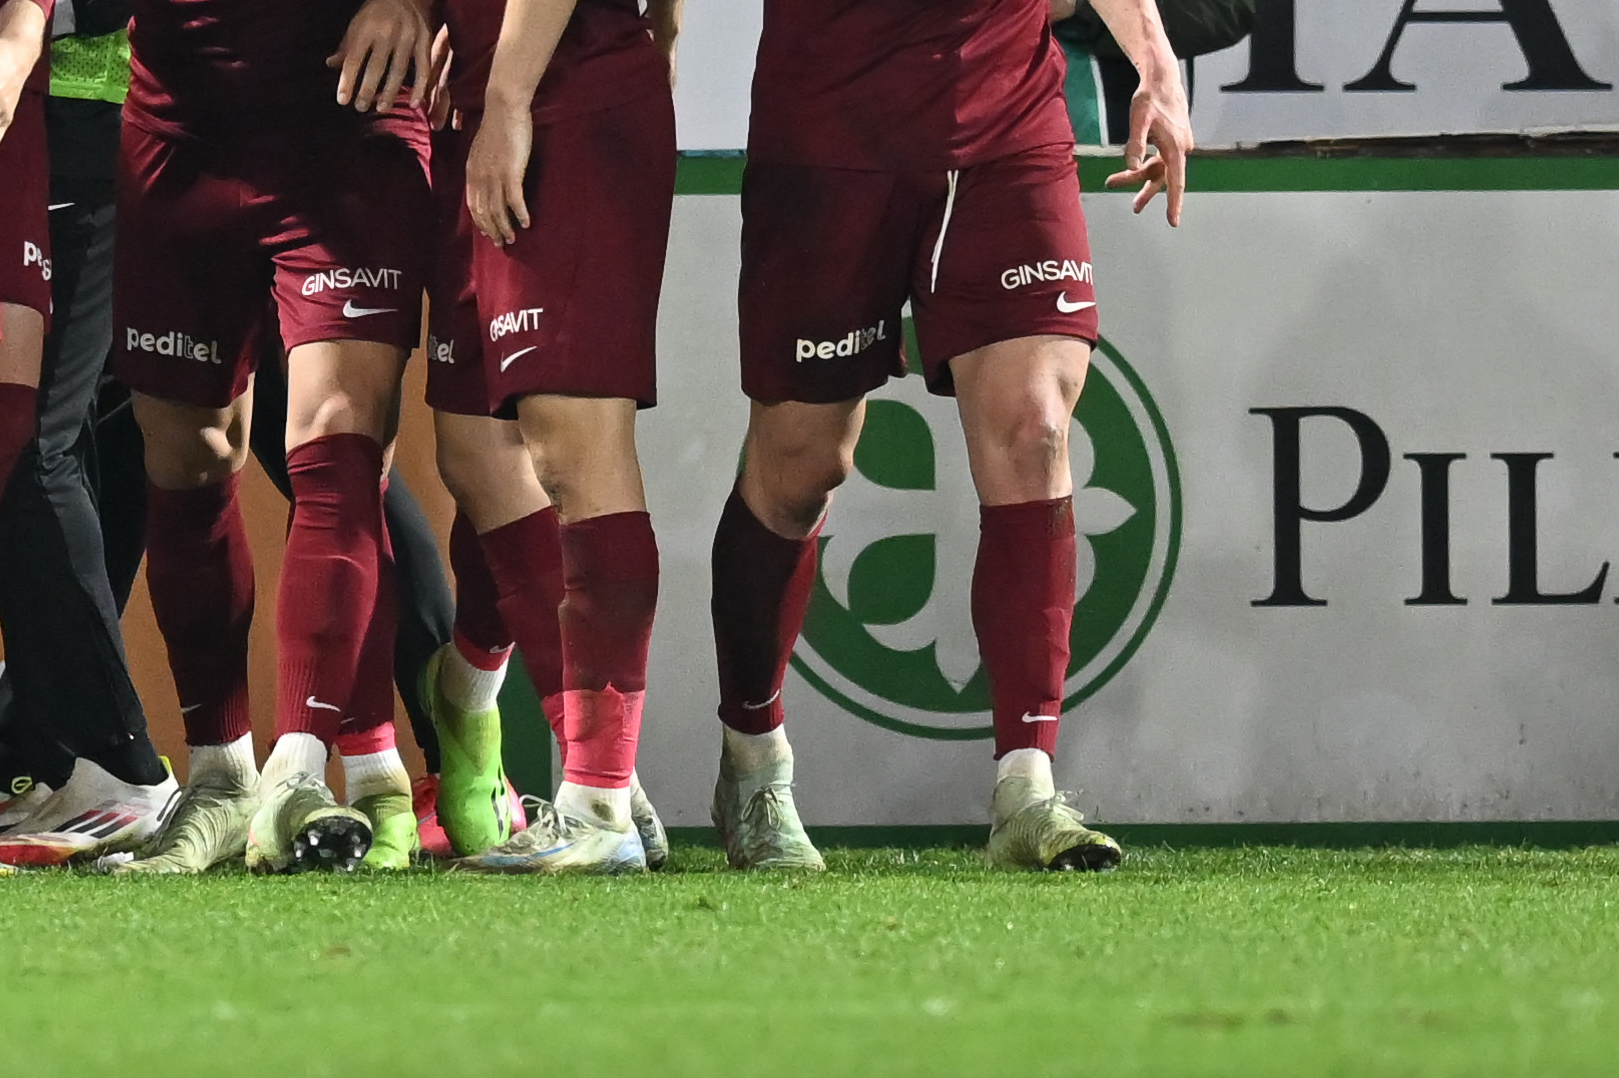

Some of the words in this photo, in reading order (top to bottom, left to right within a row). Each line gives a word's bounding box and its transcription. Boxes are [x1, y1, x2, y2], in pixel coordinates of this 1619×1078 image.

[301, 267, 402, 297] GINSAVIT
[126, 327, 222, 364] peditel
[796, 319, 886, 363] peditel
[1248, 406, 1619, 607] PIL
